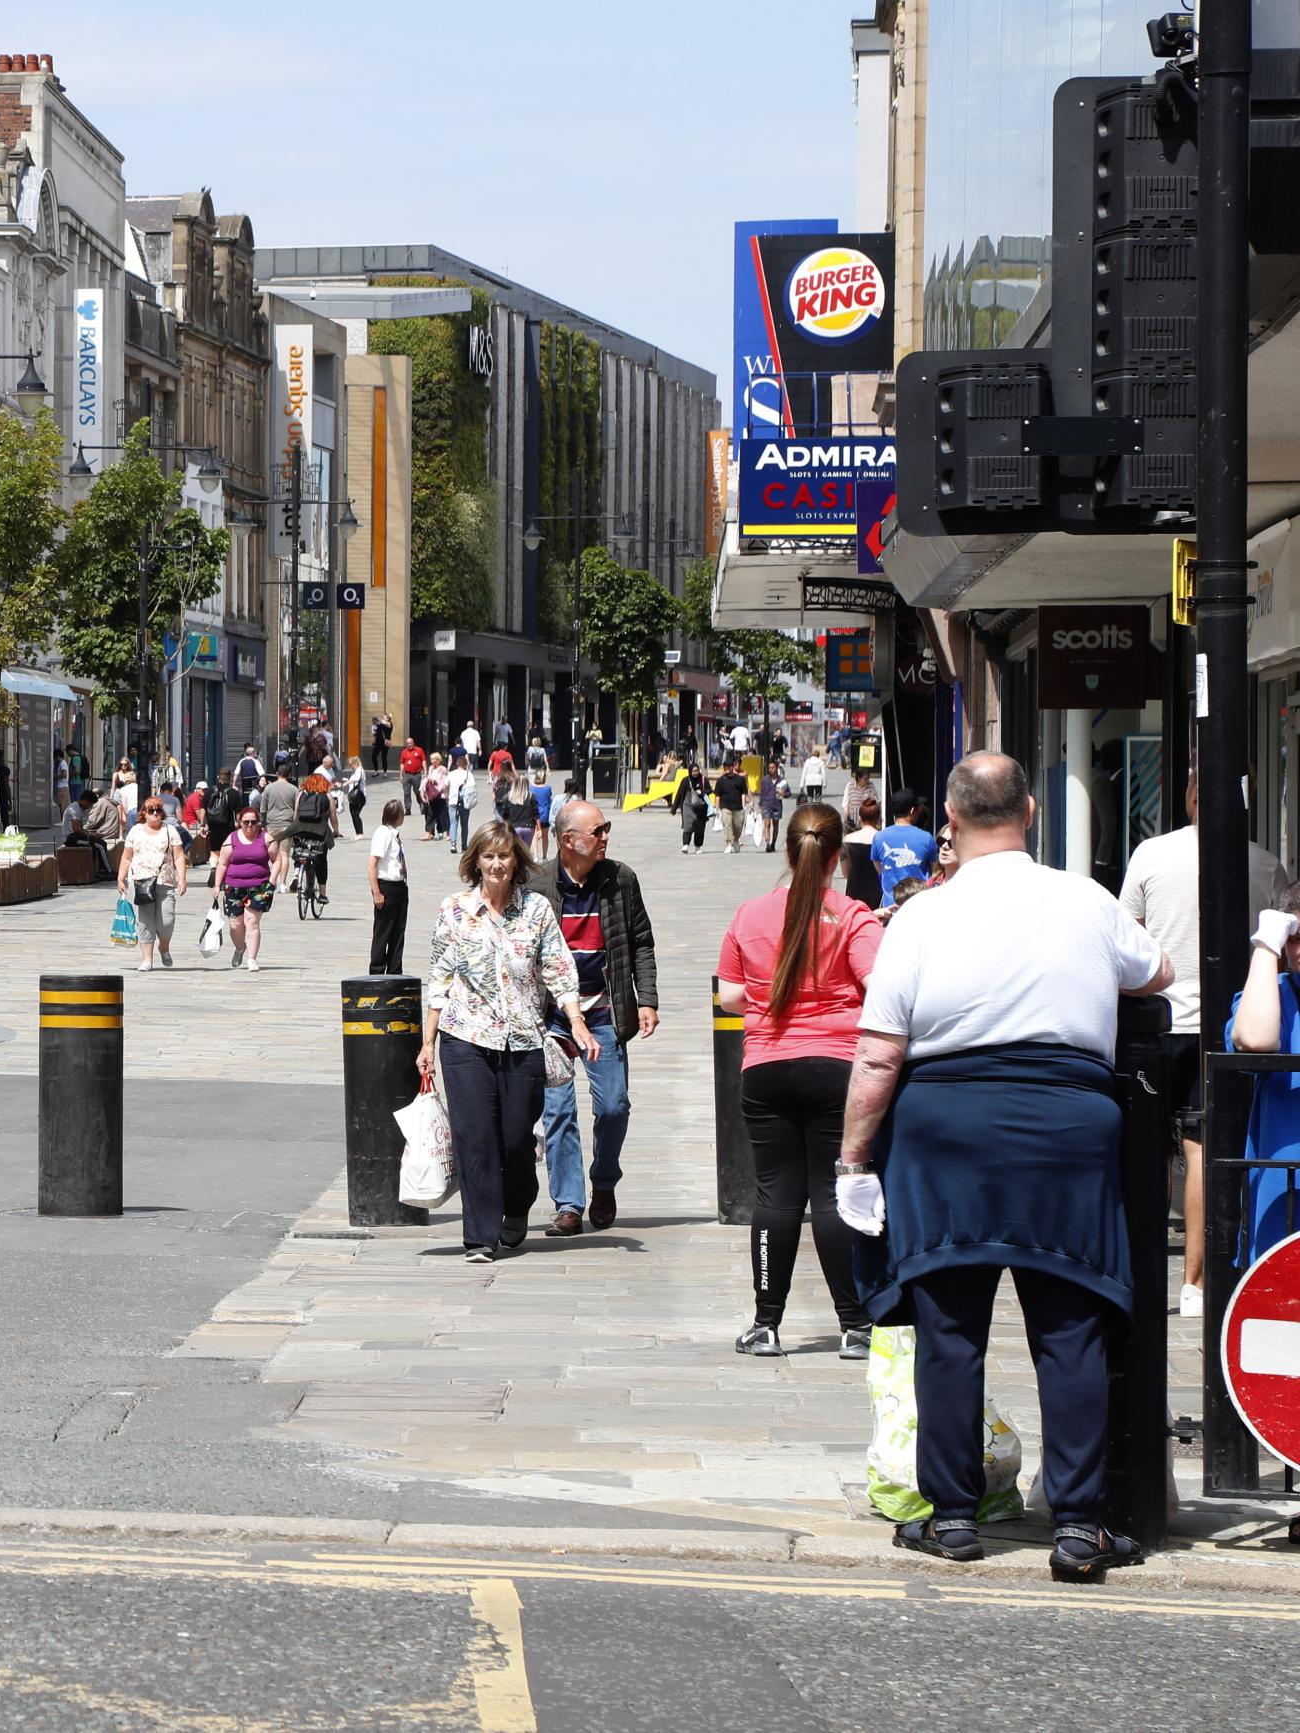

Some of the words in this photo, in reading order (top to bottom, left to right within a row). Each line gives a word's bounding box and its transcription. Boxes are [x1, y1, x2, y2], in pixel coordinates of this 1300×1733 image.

[795, 265, 874, 296] BURGER
[796, 282, 877, 322] KING
[469, 325, 493, 377] M&S
[79, 327, 96, 426] BARCLAYS
[284, 344, 307, 417] Square
[712, 438, 724, 503] Sainsbury's
[755, 443, 897, 470] ADMIRA
[763, 482, 854, 510] CASI
[343, 587, 360, 605] O2
[1052, 624, 1133, 649] scotts
[760, 1229, 768, 1244] THE
[760, 1245, 768, 1271] NORTH
[761, 1271, 769, 1291] FACE
